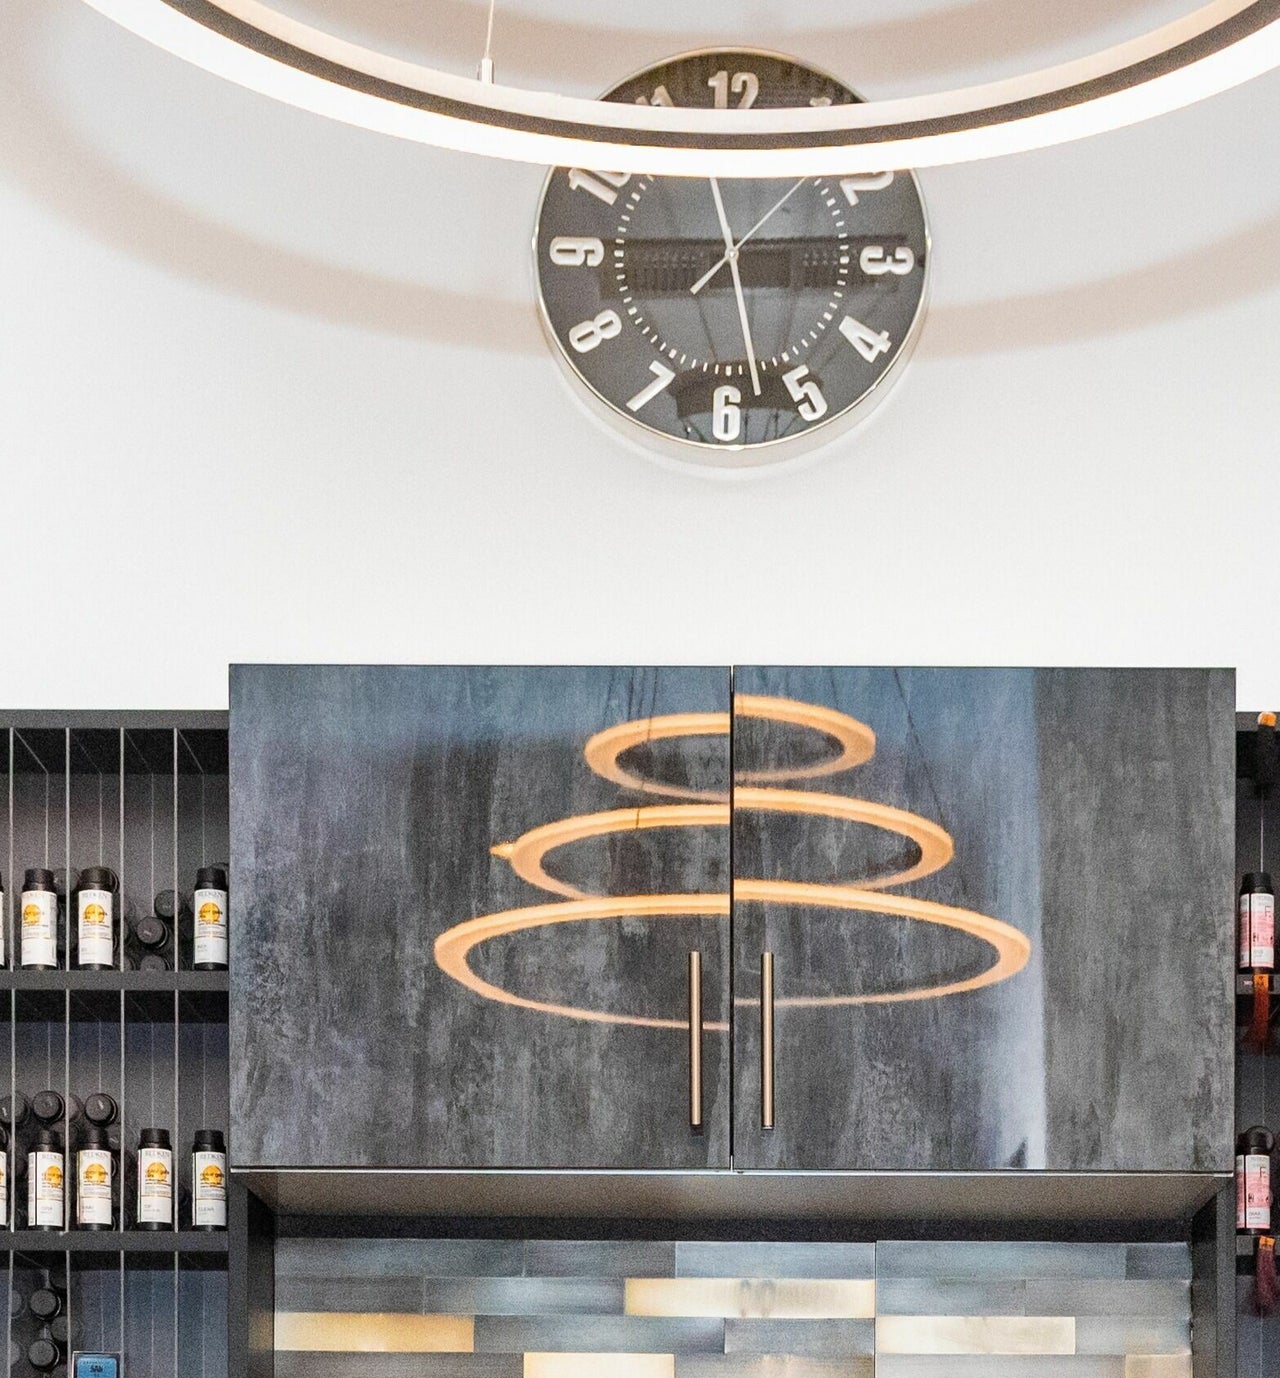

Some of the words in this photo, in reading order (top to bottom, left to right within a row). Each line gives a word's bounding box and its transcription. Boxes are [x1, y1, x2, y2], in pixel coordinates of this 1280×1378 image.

[708, 70, 759, 109] 12
[549, 235, 604, 267] 9
[859, 245, 915, 276] 3
[568, 309, 622, 354] 8
[838, 315, 892, 363] 4
[626, 360, 676, 412] 7
[782, 365, 828, 422] 5
[712, 385, 741, 441] 6
